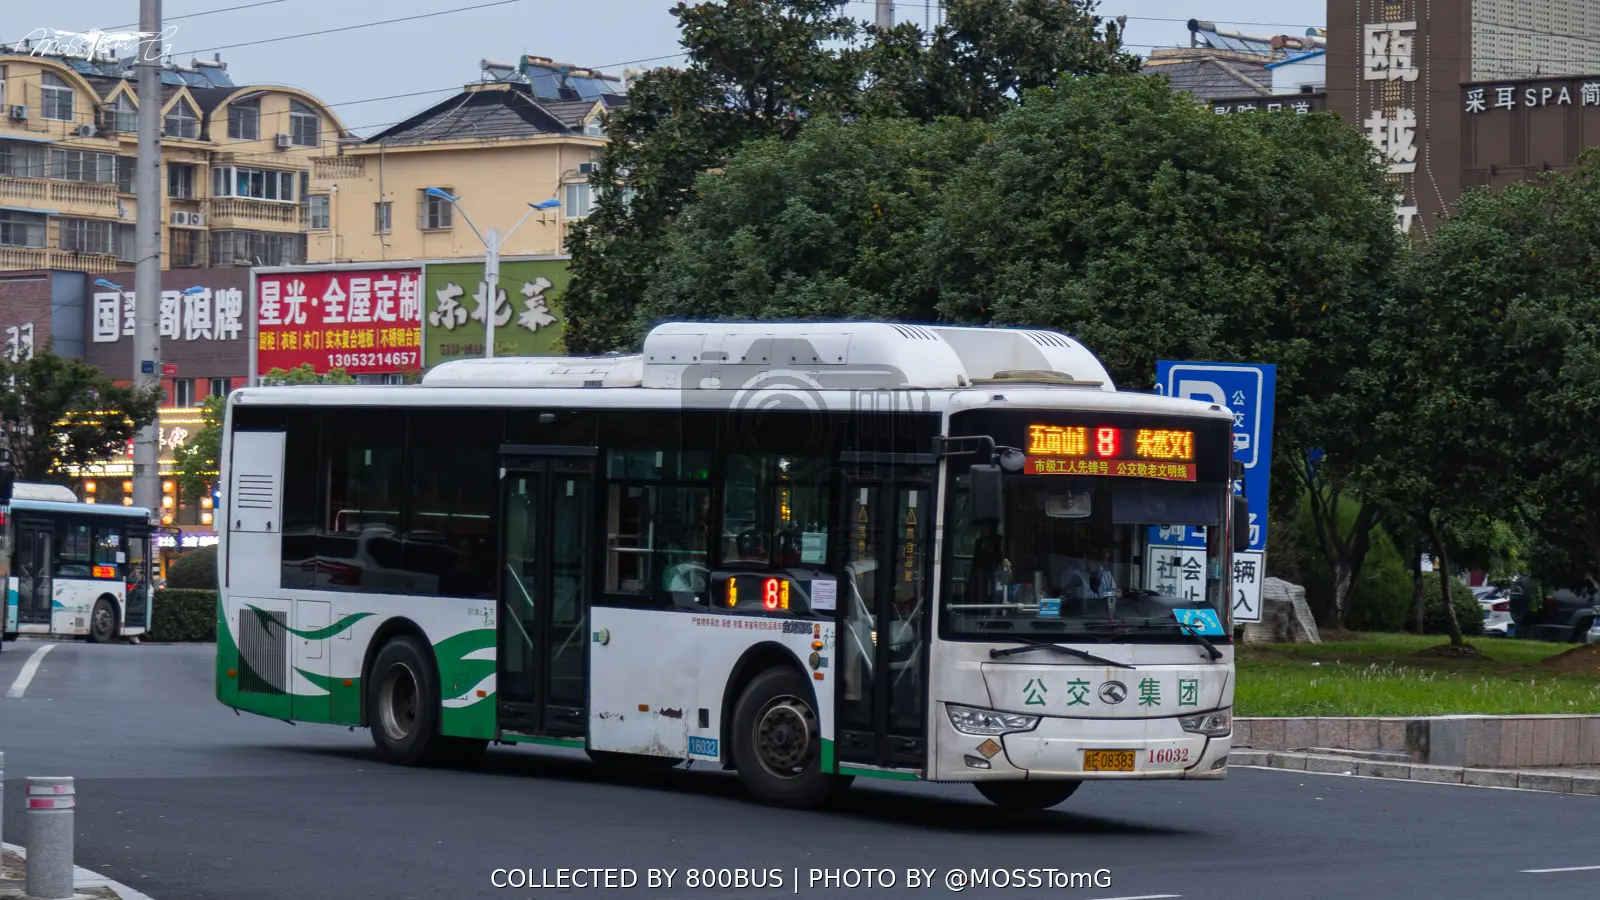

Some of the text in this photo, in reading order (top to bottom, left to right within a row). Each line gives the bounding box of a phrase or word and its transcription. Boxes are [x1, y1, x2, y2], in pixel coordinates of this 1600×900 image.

[429, 276, 557, 332] 东北菜
[327, 352, 417, 367] 13053214657
[1097, 427, 1115, 457] 8
[1035, 460, 1188, 478] 市级工人先锋号 公交敬老文明线
[1148, 748, 1189, 764] 16032
